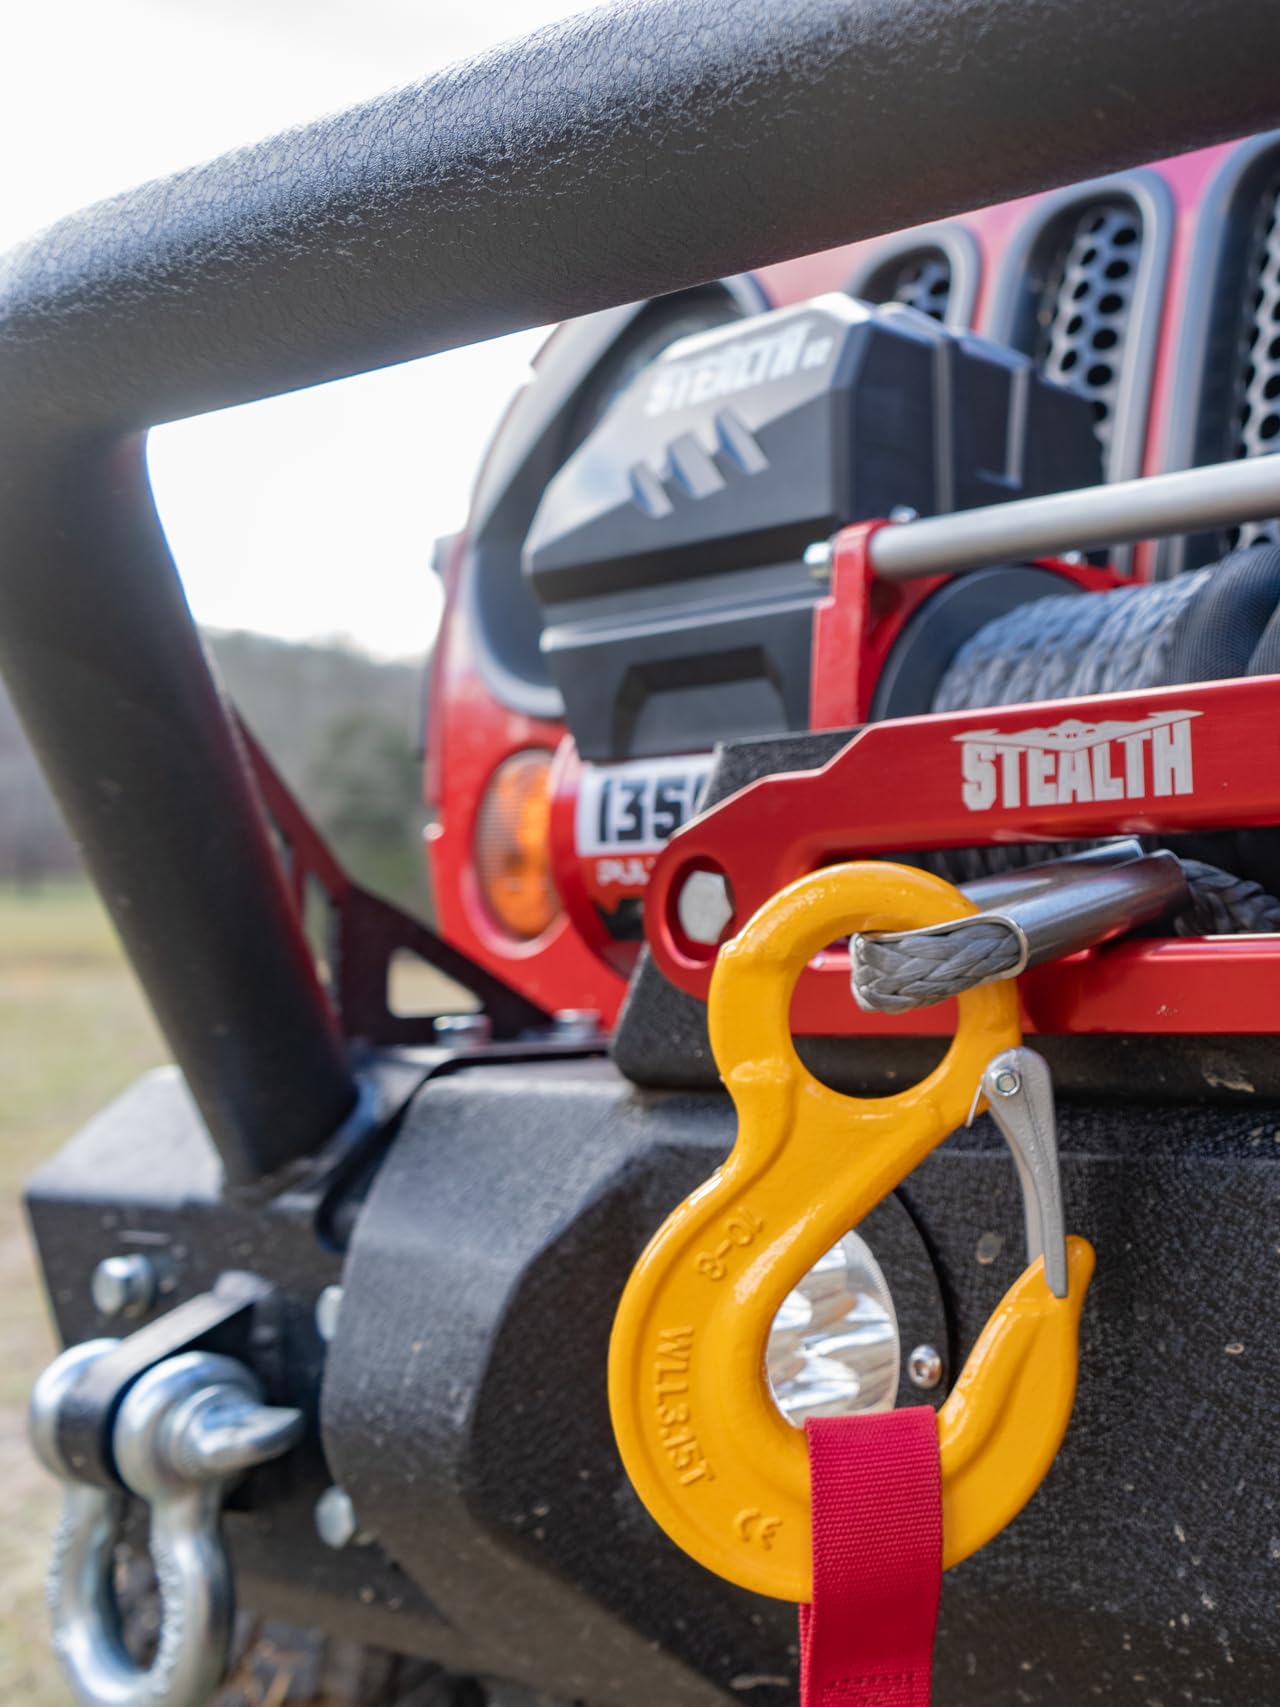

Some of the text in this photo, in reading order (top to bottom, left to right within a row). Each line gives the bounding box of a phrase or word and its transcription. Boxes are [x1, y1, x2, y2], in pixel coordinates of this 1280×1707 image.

[645, 320, 816, 417] STEALTH
[962, 718, 1194, 811] STEALTH
[599, 774, 705, 842] 135
[597, 857, 656, 886] PUL
